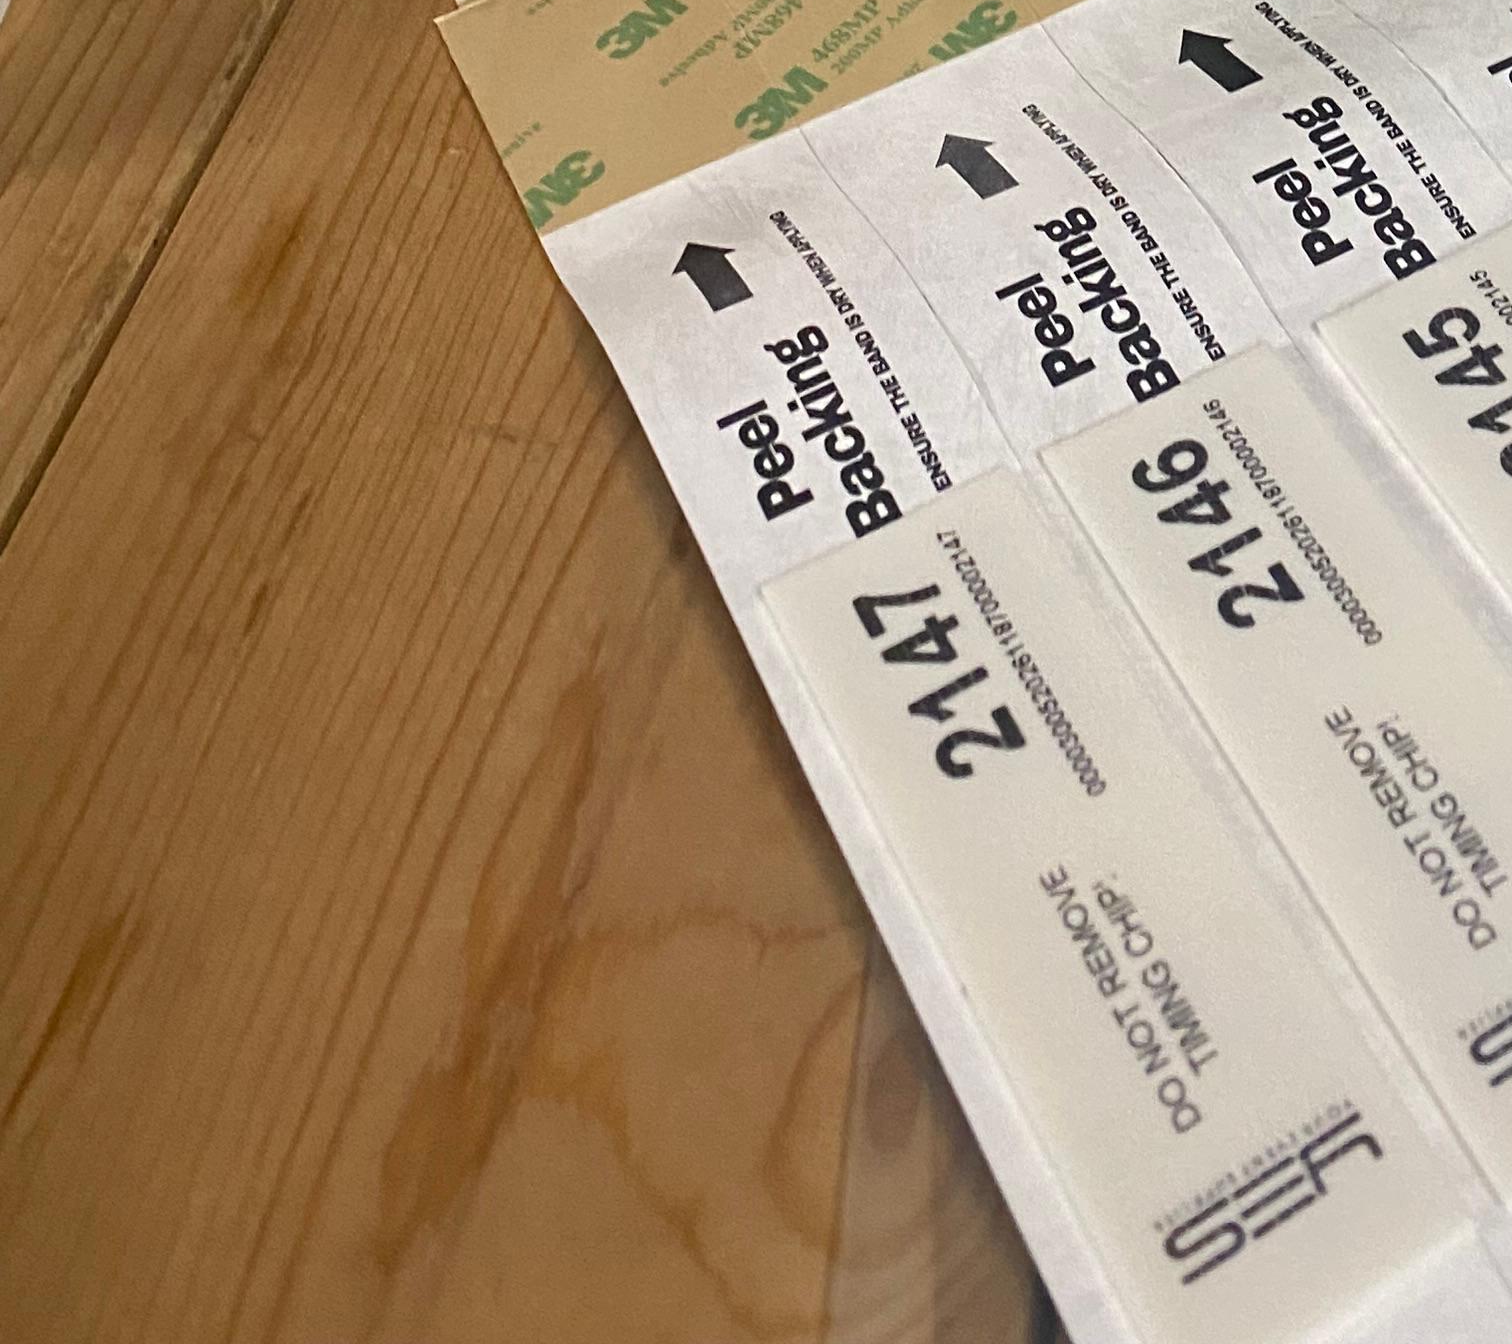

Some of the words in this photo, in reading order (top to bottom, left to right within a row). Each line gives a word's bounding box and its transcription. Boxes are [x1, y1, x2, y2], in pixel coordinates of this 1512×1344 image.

[811, 0, 882, 63] 468MP
[734, 64, 829, 141] 3M
[1252, 158, 1353, 265] Peel
[1282, 96, 1436, 279] Backing
[803, 251, 835, 287] WHEN
[826, 287, 854, 313] DRY
[1034, 207, 1180, 402] Backing
[845, 314, 863, 330] IS
[855, 330, 889, 375] BAND
[995, 272, 1095, 387] Peel
[763, 325, 902, 537] Backing
[880, 375, 909, 413] THE
[716, 399, 813, 520] Peel
[901, 412, 952, 491] ENSURE
[1132, 439, 1304, 627] 2146
[853, 583, 1025, 777] 2147
[1325, 707, 1416, 827] REMOVE
[1403, 833, 1461, 895] NOT
[1430, 791, 1506, 897] TIMING
[1040, 866, 1126, 996] REMOVE
[1453, 899, 1496, 949] DO
[1112, 1004, 1168, 1074] NOT
[1142, 959, 1217, 1075] TIMING
[1158, 1076, 1201, 1132] DO
